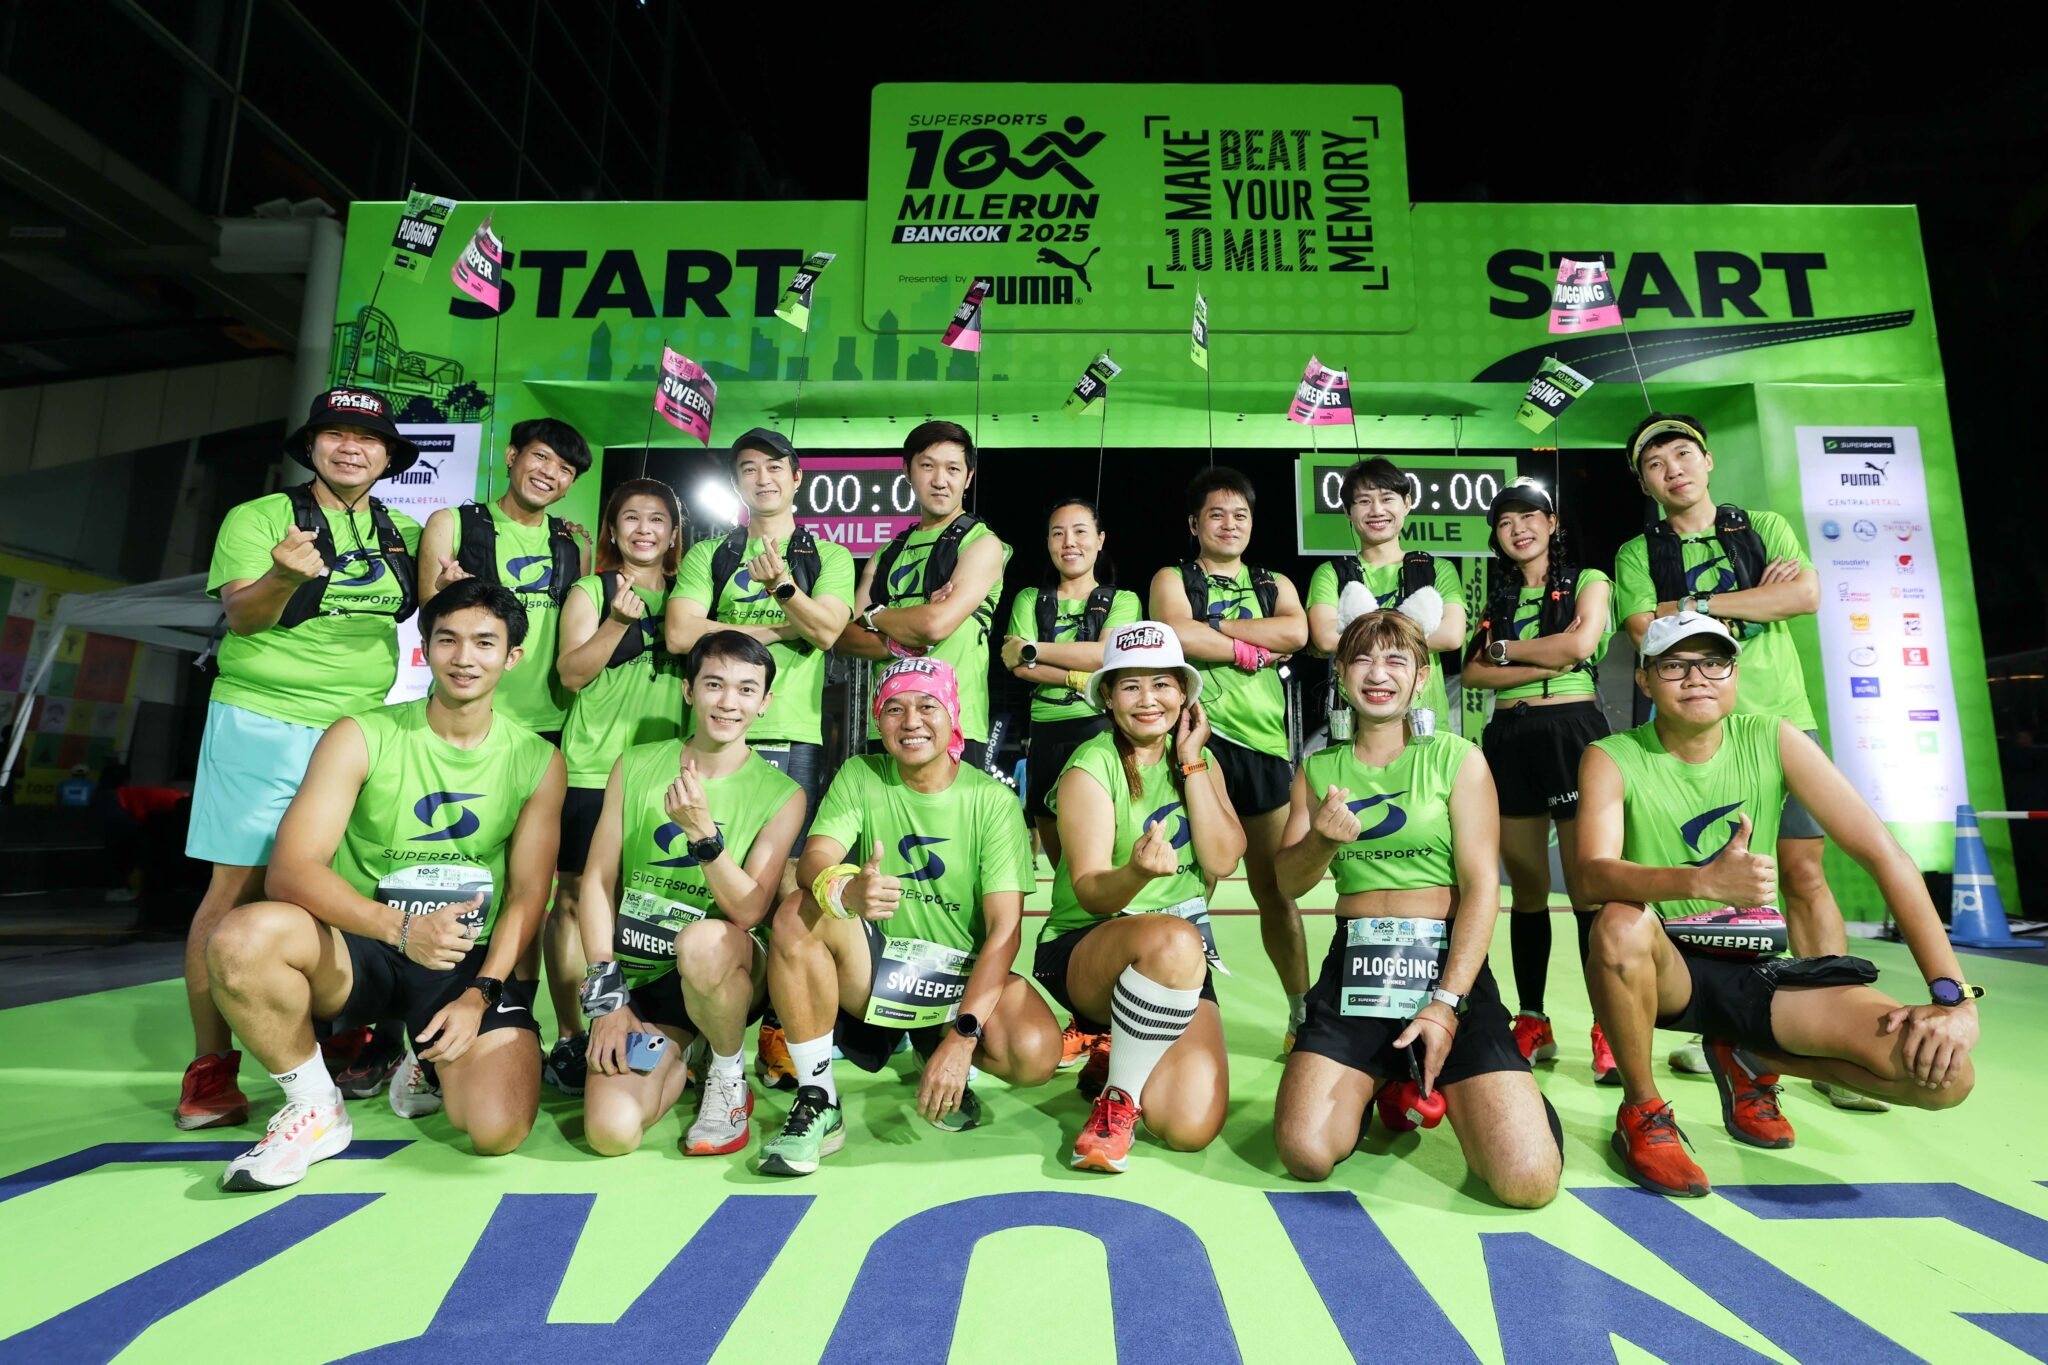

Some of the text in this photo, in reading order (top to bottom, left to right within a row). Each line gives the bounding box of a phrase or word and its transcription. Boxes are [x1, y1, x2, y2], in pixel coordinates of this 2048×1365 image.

[908, 113, 1048, 127] SUPERSPORTS
[905, 128, 1011, 190] 10
[1220, 129, 1311, 171] BEAT
[1163, 129, 1212, 220] MAKE
[897, 193, 1100, 220] MILERUN
[1222, 179, 1315, 221] YOUR
[1321, 129, 1375, 272] MEMORY
[397, 218, 438, 247] PLOGGING
[901, 223, 1090, 243] BANGKOK 2025
[1165, 227, 1318, 272] 10 MILE
[898, 274, 967, 285] Presented by
[1485, 248, 1828, 319] SART
[331, 394, 380, 407] PACER
[663, 376, 711, 421] SWEEPER
[1840, 441, 1893, 449] SUPERSPORTS
[391, 471, 432, 485] PUMA
[1841, 473, 1881, 486] PUMA
[381, 497, 448, 505] ENTRALRETAIL
[1118, 627, 1164, 646] PACER
[622, 927, 675, 956] SWEEPE
[1678, 934, 1774, 951] SWEEPER
[1352, 956, 1439, 980] PLOGGING
[886, 971, 965, 999] SWEEPER
